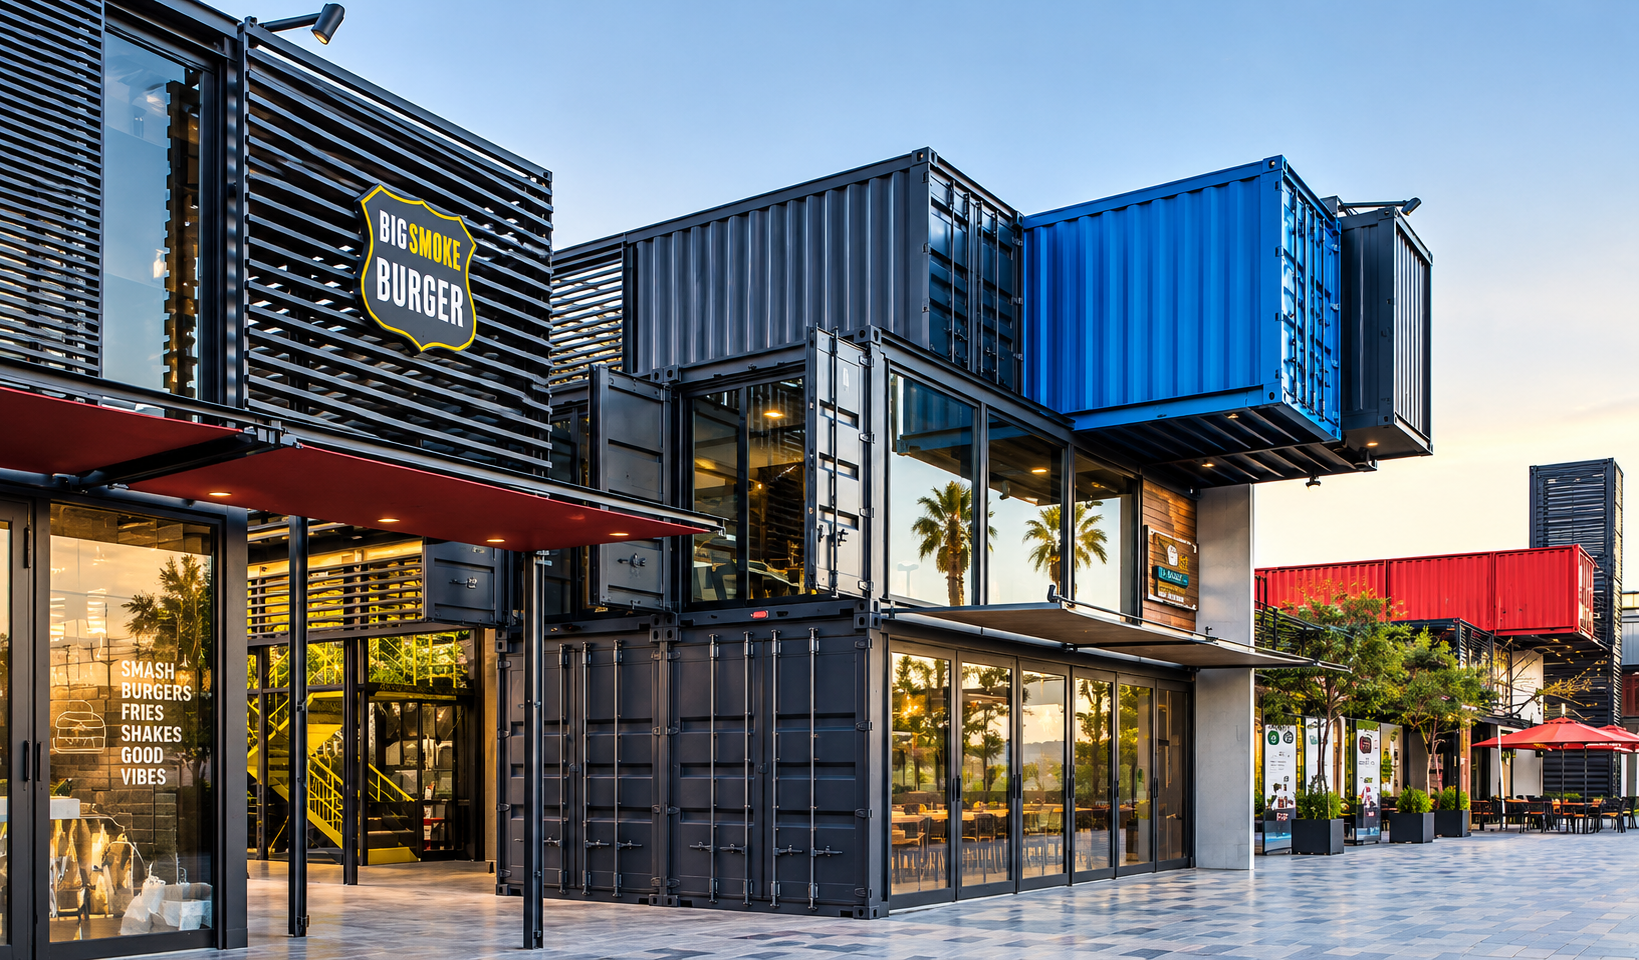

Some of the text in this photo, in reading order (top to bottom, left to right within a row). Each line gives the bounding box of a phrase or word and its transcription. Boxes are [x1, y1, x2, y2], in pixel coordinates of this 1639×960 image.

[379, 209, 461, 272] BIG SMOKE
[376, 256, 464, 328] BURGER
[121, 660, 175, 680] SMASH
[121, 682, 192, 702] BURGERS
[121, 703, 164, 721] FRIES
[121, 724, 182, 743] SHAKES
[121, 746, 164, 764] GOOD
[121, 768, 166, 785] VIBES
